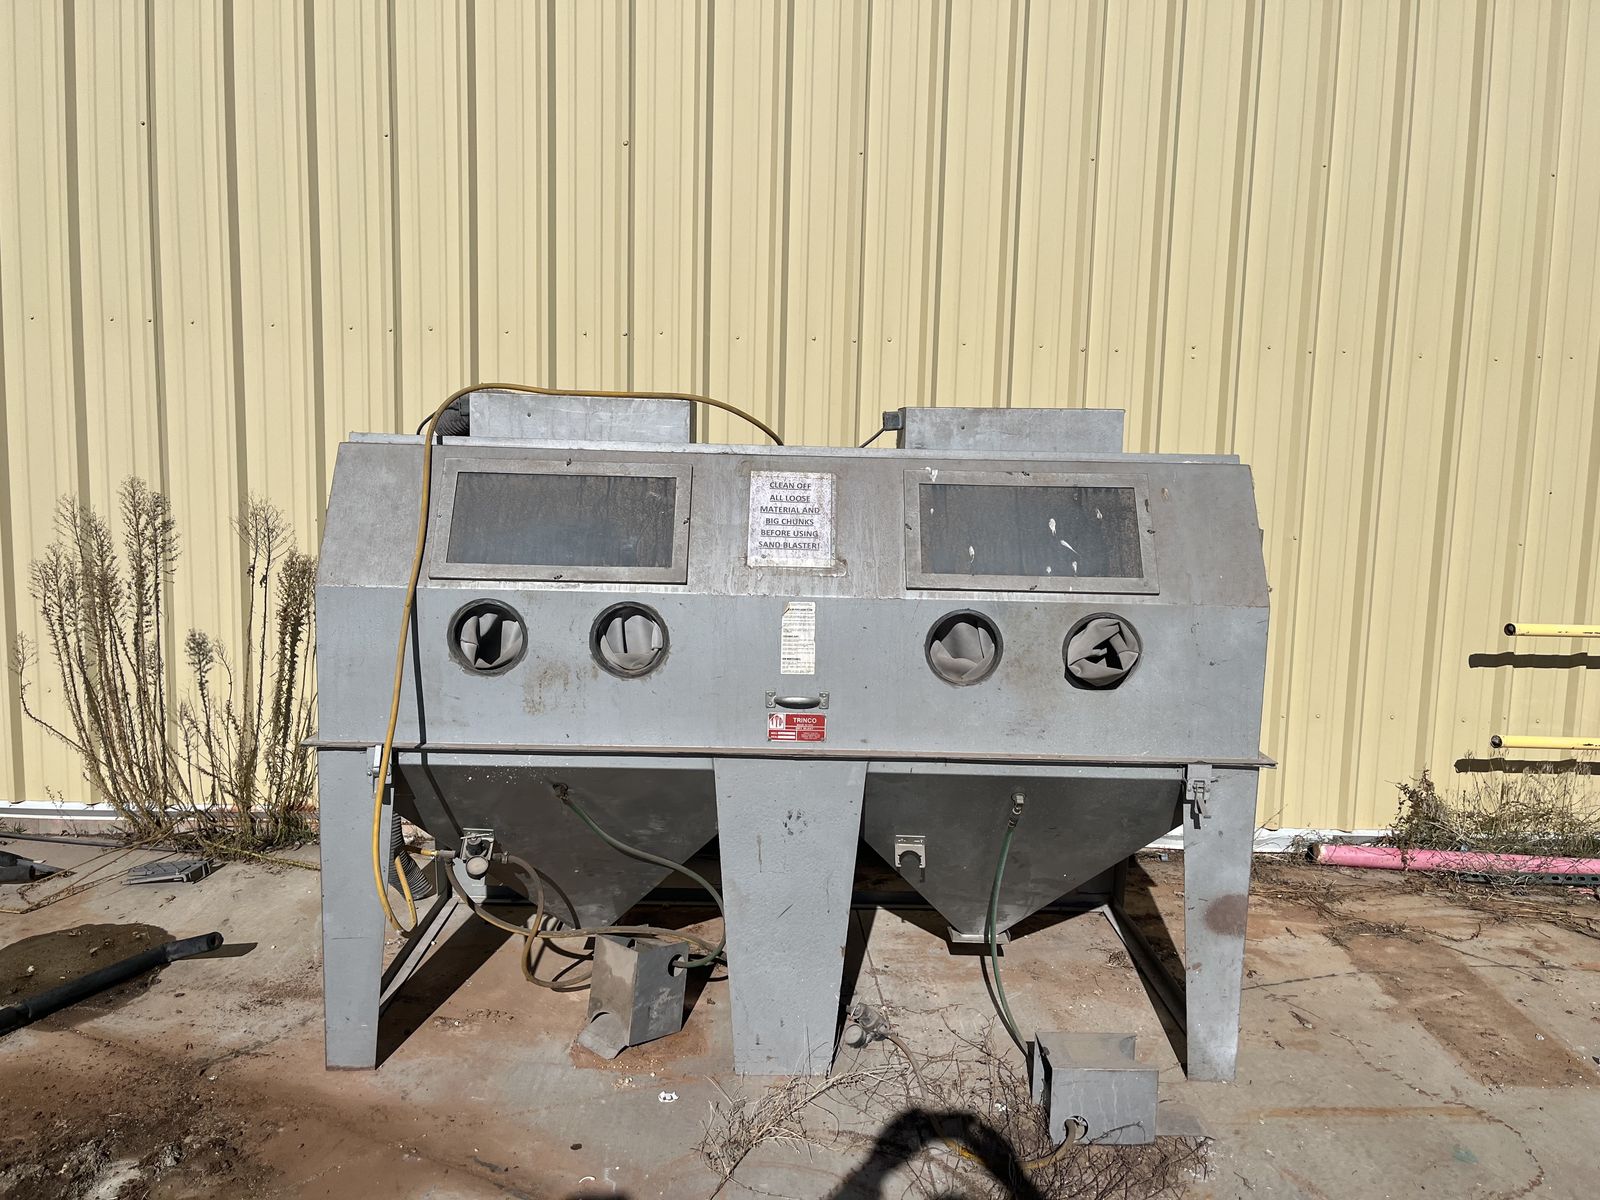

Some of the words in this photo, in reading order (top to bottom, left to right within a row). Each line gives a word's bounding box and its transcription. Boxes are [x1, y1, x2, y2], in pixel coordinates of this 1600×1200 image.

[769, 481, 795, 489] CLEAN
[796, 482, 812, 490] OFF
[769, 494, 783, 502] ALL
[785, 495, 811, 503] LOOSE
[760, 506, 800, 514] MATERIAL
[760, 529, 791, 537] BEFORE
[792, 530, 819, 538] USING
[783, 542, 820, 550] BLASTER!
